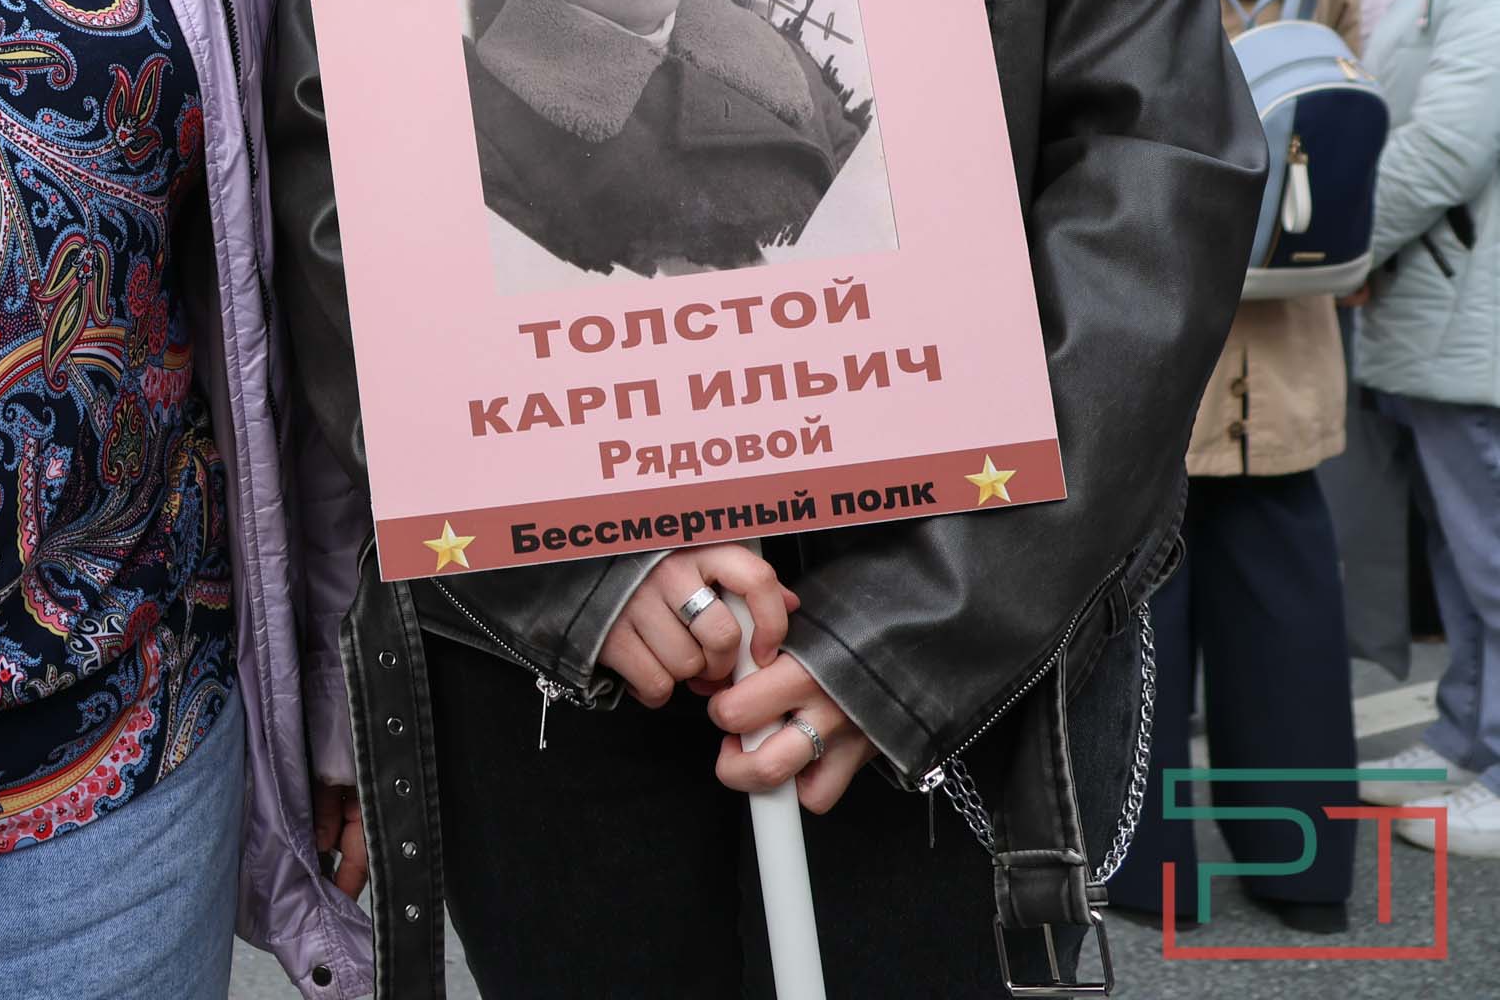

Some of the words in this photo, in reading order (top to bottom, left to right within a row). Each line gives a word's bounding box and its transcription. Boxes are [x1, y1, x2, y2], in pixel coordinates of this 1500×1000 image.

[518, 275, 871, 359] ТОЛСТОЙ
[468, 378, 661, 437] КАРП
[687, 344, 942, 411] ИЛЬИЧ
[598, 414, 833, 480] Рядовой
[511, 489, 817, 554] Бессмертный
[830, 481, 937, 516] полк
